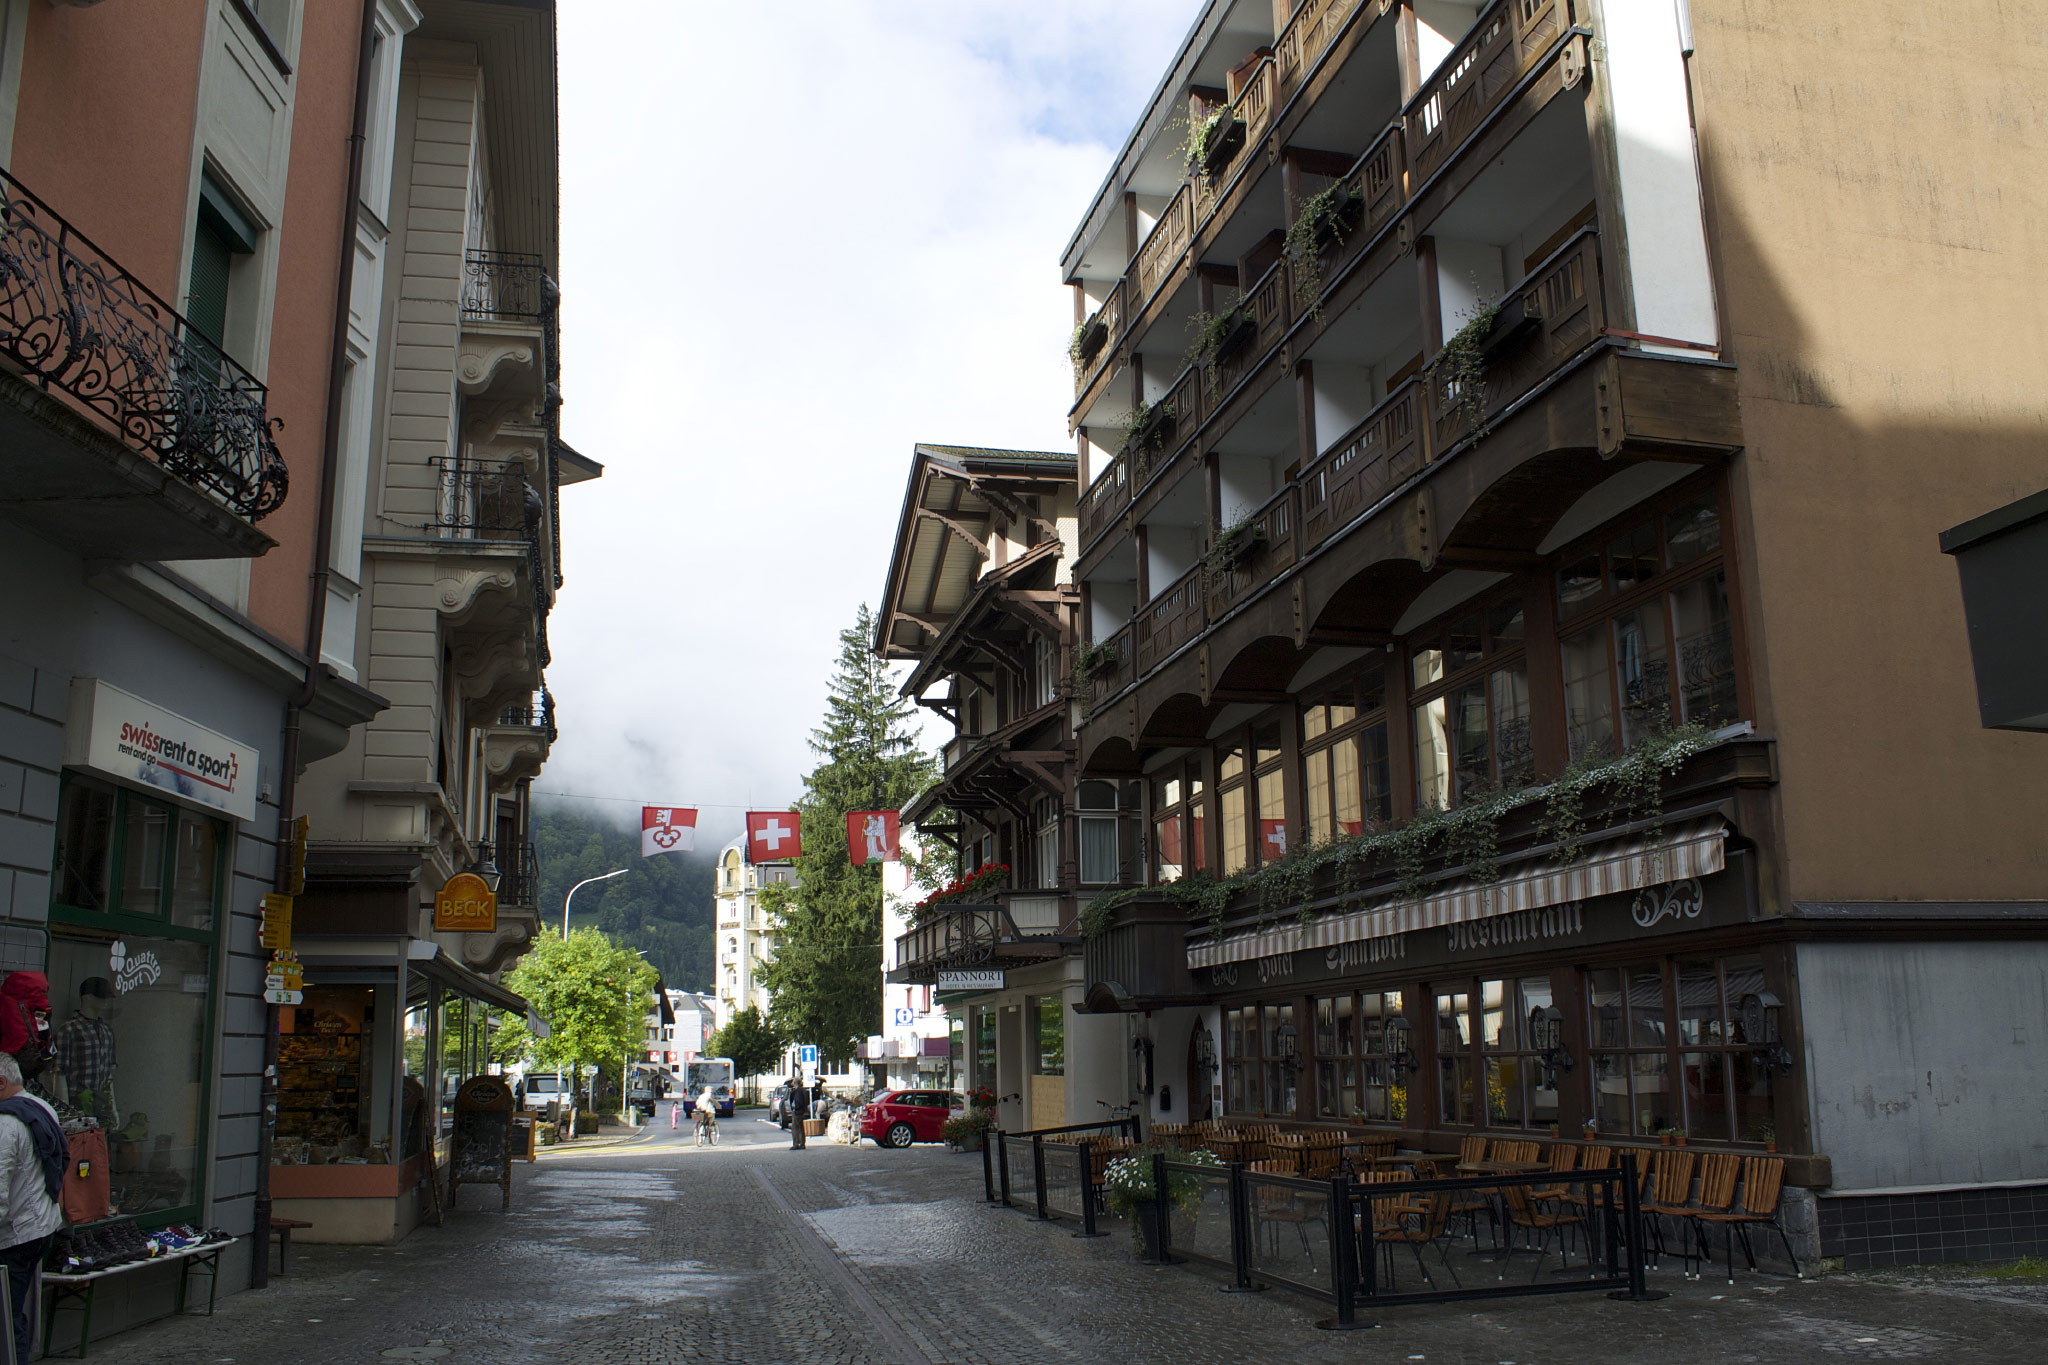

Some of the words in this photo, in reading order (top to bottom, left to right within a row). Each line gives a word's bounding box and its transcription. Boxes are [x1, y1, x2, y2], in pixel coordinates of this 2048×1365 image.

[118, 743, 133, 756] rent
[133, 748, 147, 762] and
[147, 754, 156, 766] go
[120, 721, 187, 763] swissrent
[187, 749, 197, 767] a
[197, 753, 231, 779] sport
[441, 900, 489, 917] BECK
[1448, 900, 1583, 952] Restaurant
[126, 950, 161, 977] Quattro
[115, 971, 143, 995] Sport
[939, 971, 1001, 982] SPANNORT
